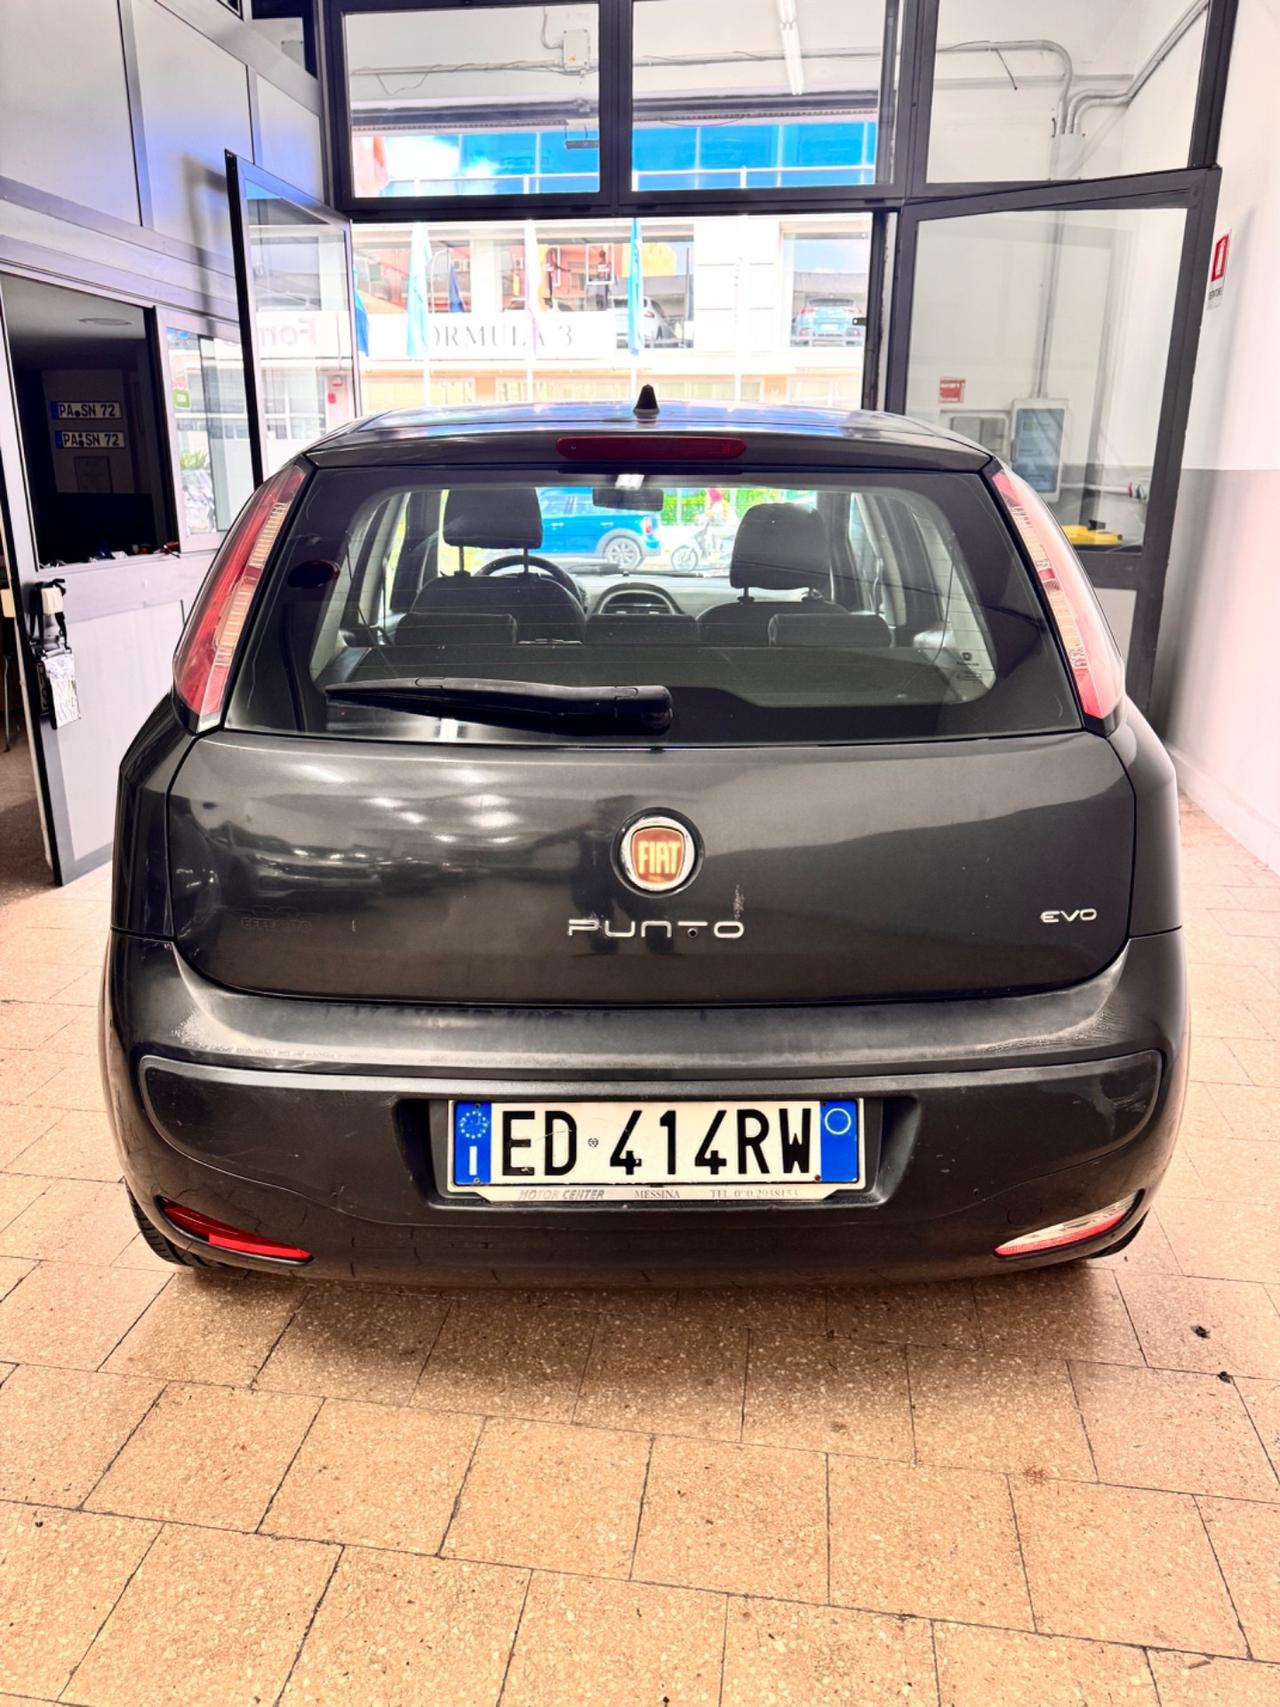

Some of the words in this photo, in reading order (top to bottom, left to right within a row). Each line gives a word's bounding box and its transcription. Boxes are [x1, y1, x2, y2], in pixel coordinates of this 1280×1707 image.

[421, 326, 545, 347] ORMULA
[559, 325, 573, 346] 3
[100, 404, 116, 417] 72
[104, 433, 120, 446] 72
[638, 840, 681, 874] FIAT
[1040, 908, 1098, 923] EVO
[567, 918, 745, 939] PUNTO
[502, 1110, 578, 1177] ED
[609, 1108, 812, 1176] 414RW
[562, 1188, 605, 1201] CENTER
[634, 1189, 681, 1200] MESSINA
